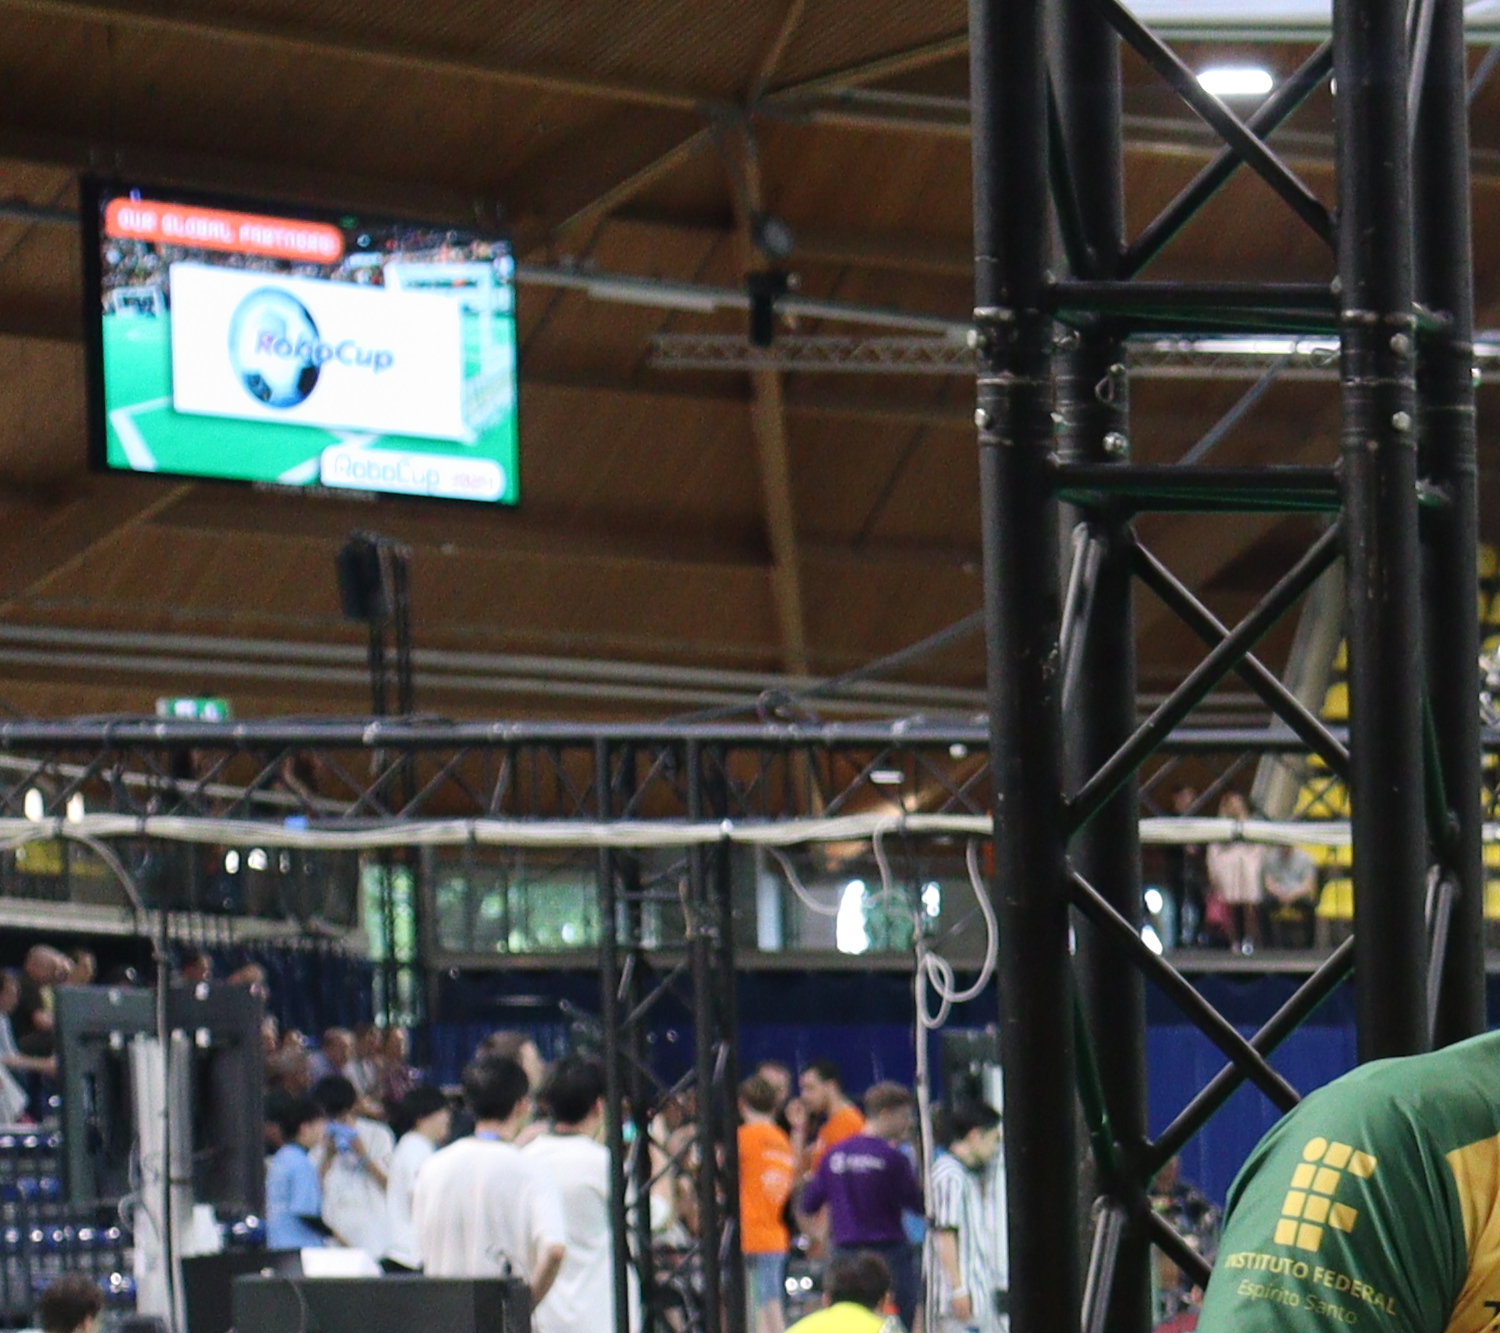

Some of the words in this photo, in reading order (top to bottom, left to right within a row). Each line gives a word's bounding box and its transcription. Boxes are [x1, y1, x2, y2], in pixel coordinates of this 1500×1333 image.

[255, 331, 394, 374] RoboCup
[1305, 1293, 1358, 1326] Santo
[1313, 1266, 1397, 1317] FEDERAL
